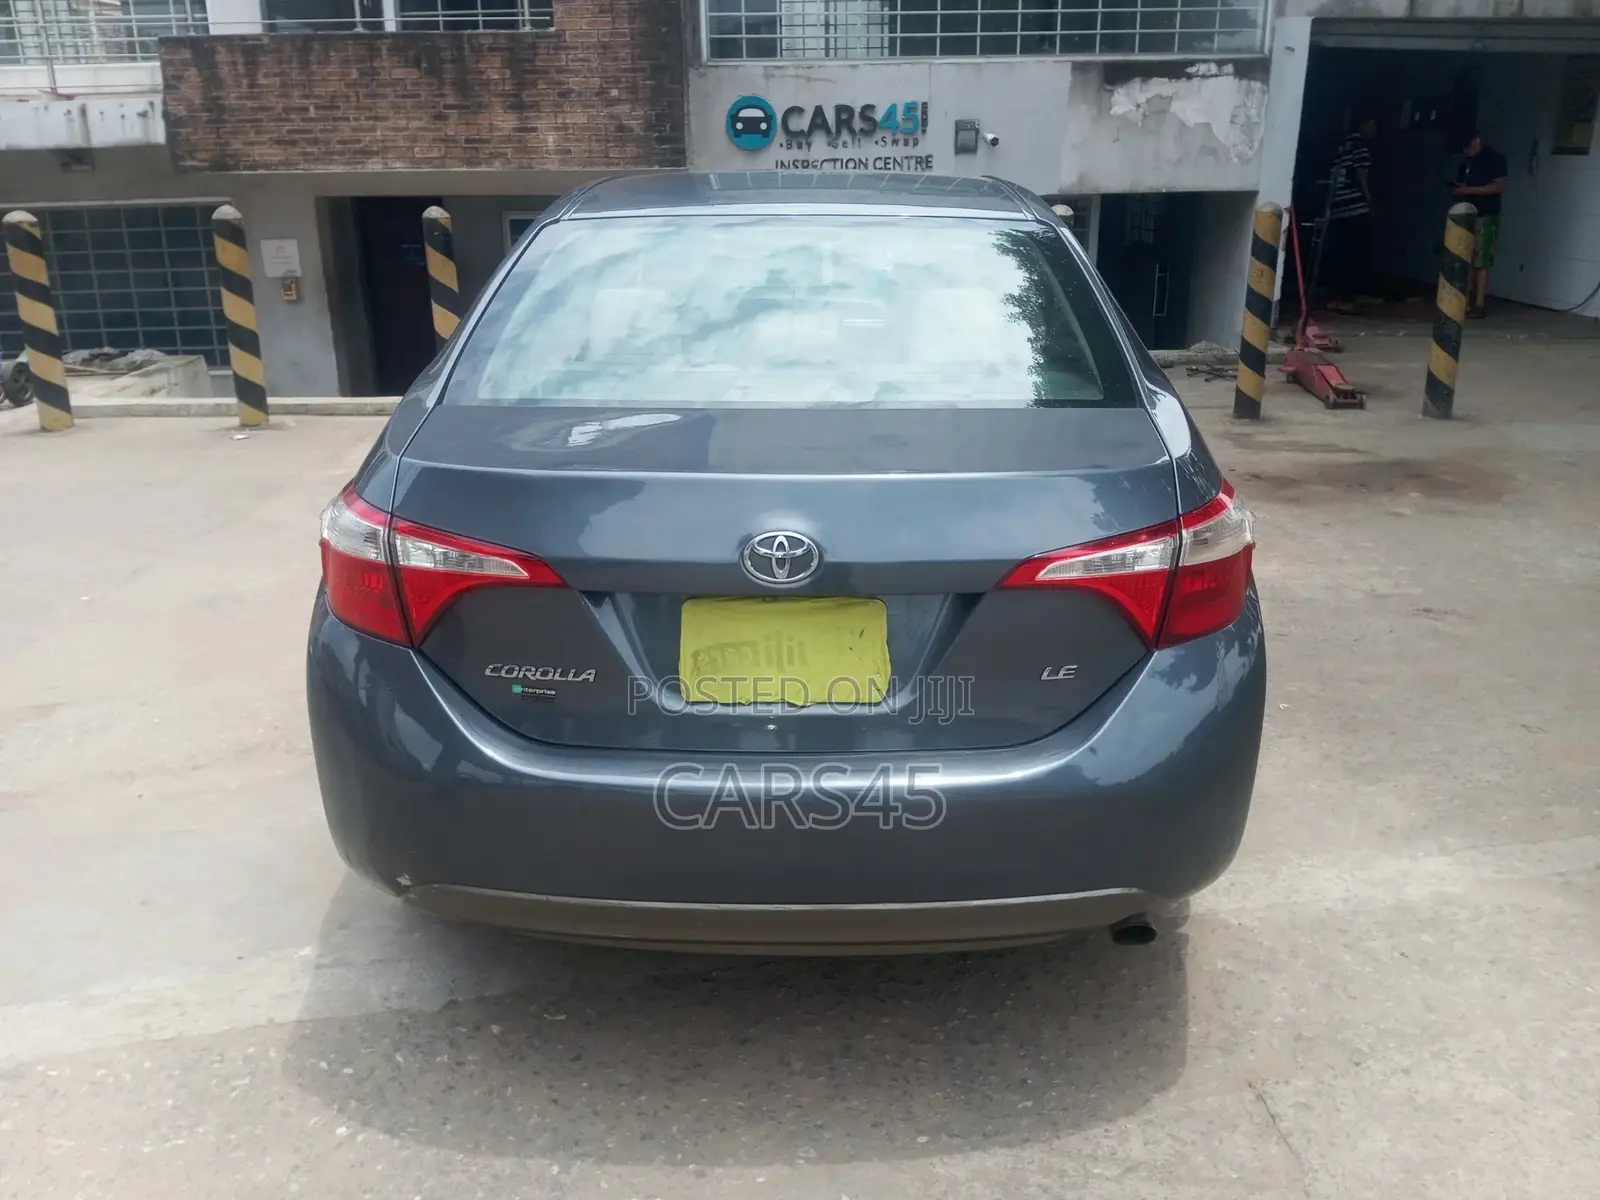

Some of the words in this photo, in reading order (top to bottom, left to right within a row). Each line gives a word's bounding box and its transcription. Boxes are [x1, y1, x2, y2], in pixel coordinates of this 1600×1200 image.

[781, 101, 920, 138] CARS45
[873, 155, 933, 171] CENTRE
[485, 664, 597, 682] COROLLA
[1040, 665, 1078, 681] LE
